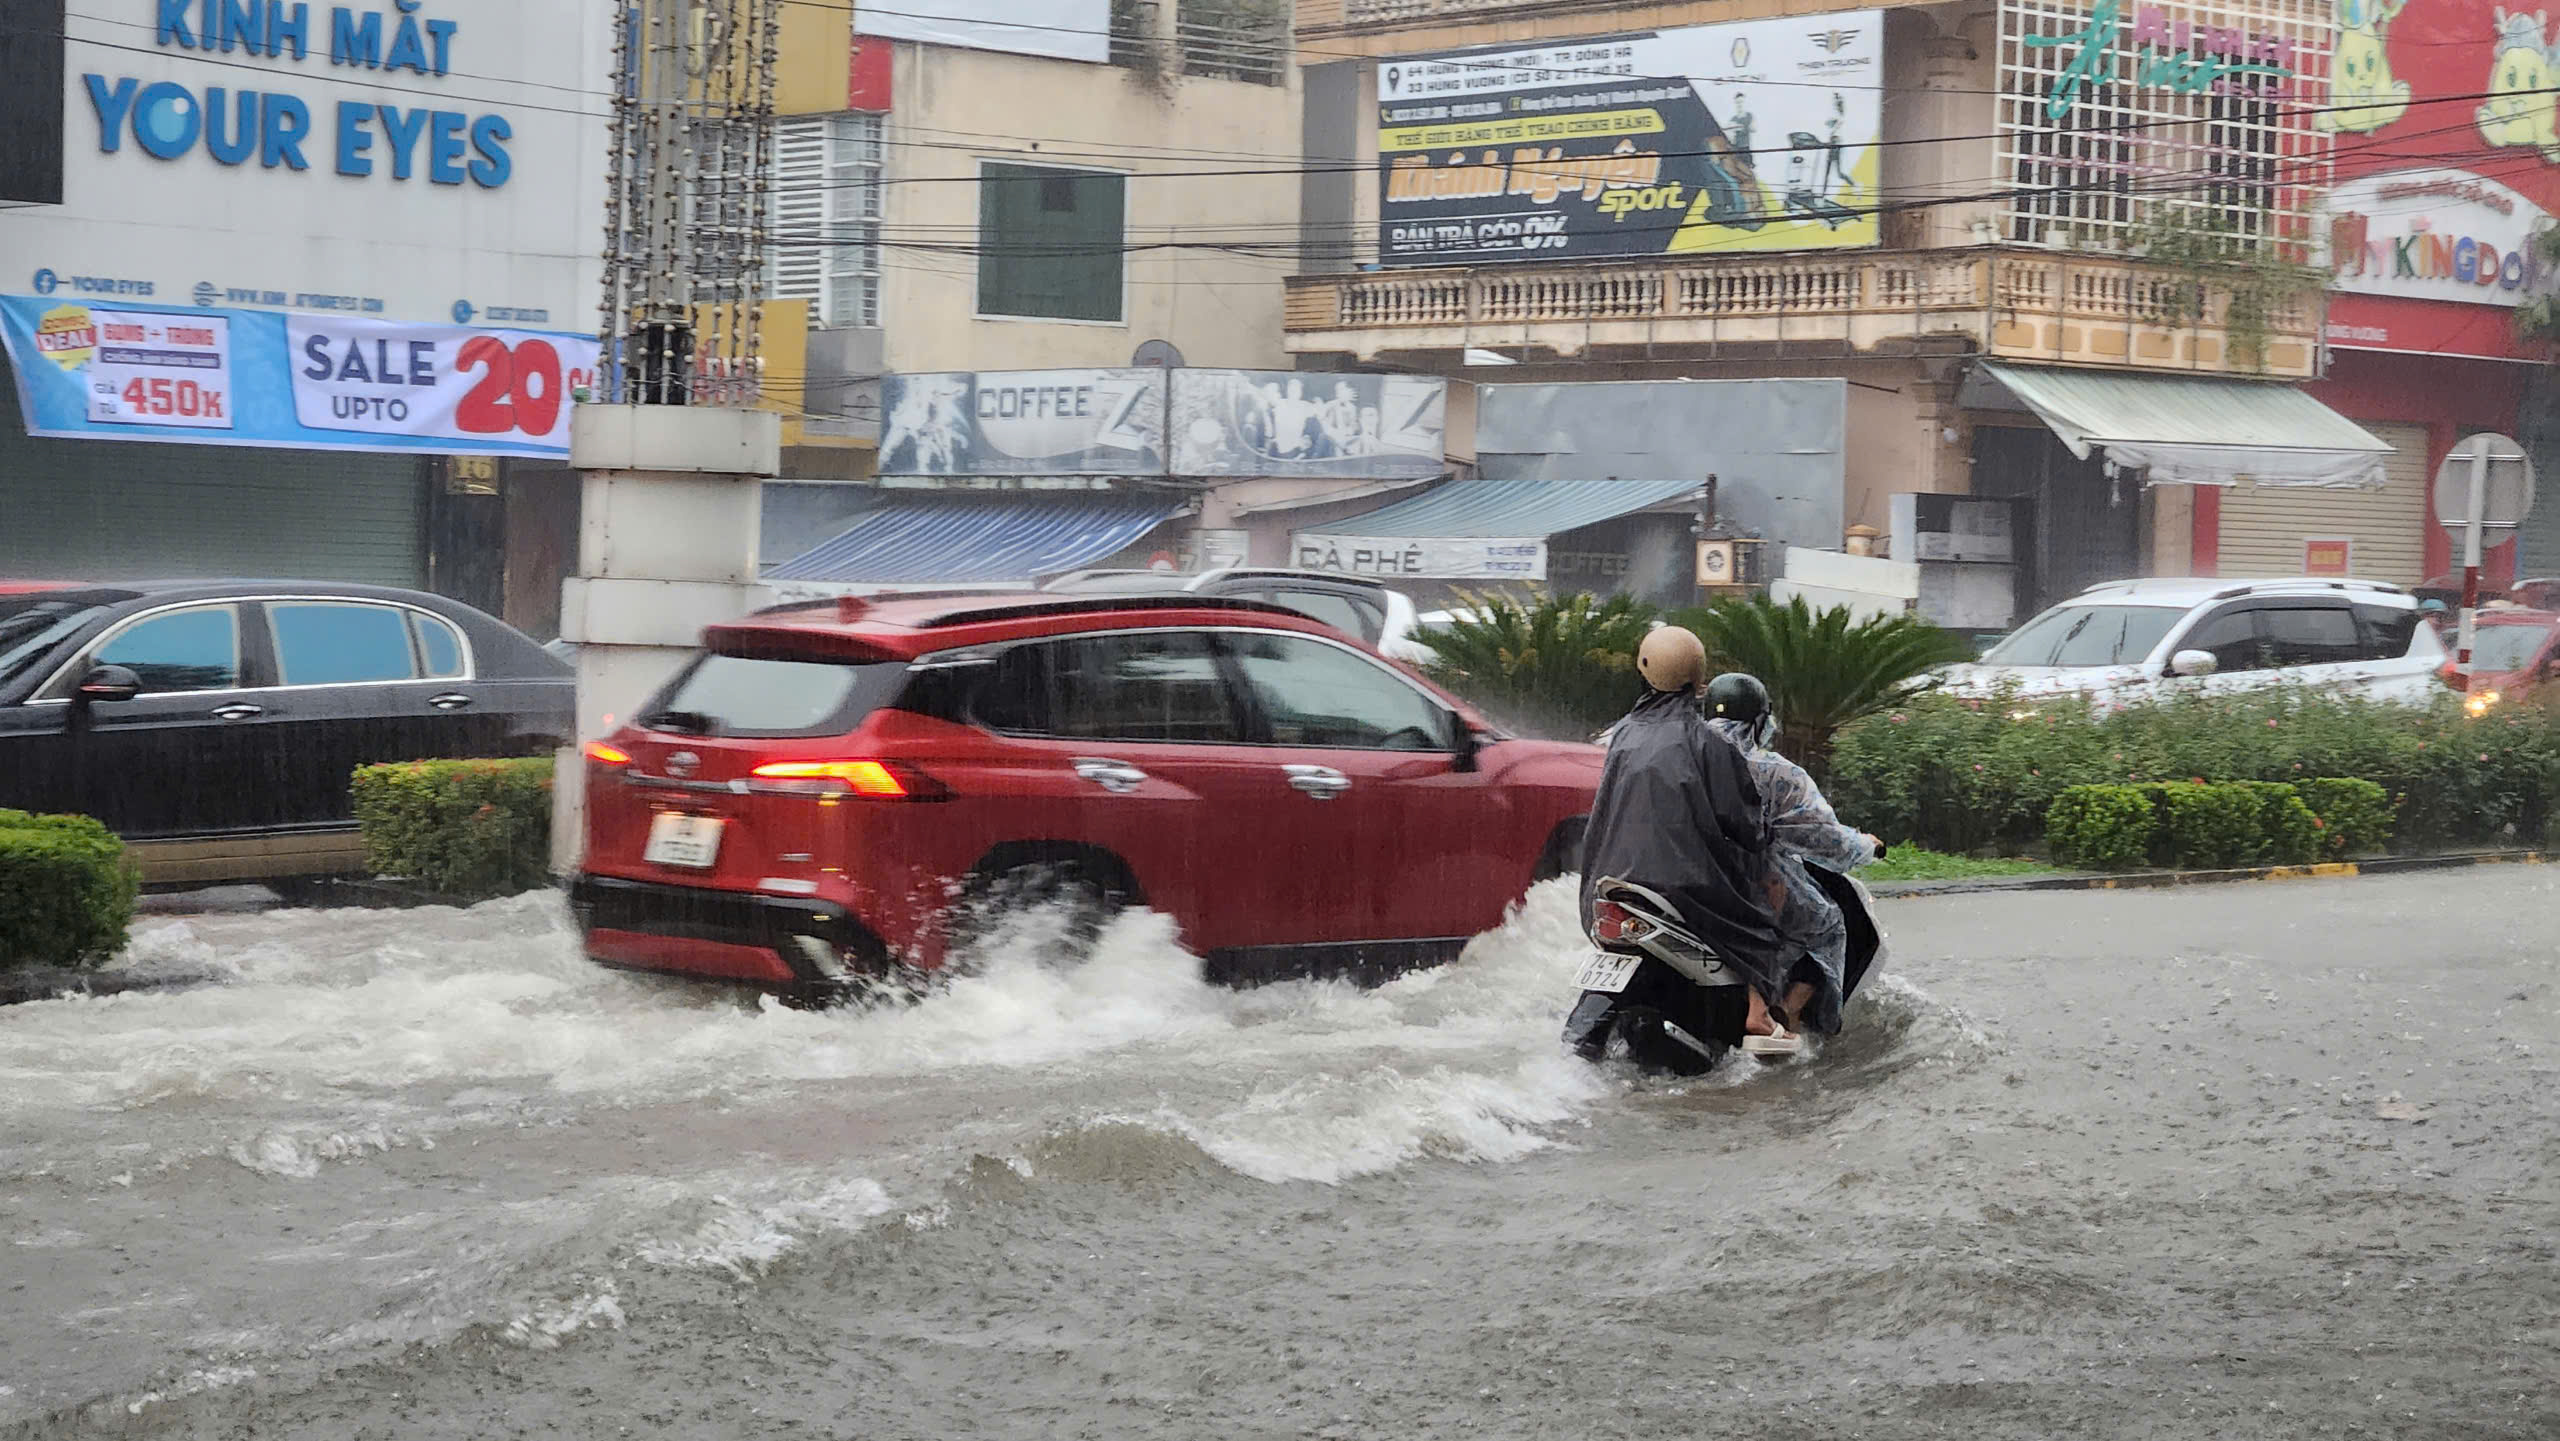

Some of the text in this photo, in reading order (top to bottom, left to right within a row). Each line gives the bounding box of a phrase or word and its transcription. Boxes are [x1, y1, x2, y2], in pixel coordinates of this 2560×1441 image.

[82, 73, 513, 189] YOUR EYES
[1597, 181, 1688, 222] sport
[1391, 223, 1435, 250] BÁN
[1520, 215, 1569, 250] 0%
[39, 327, 93, 351] DEAL
[303, 334, 437, 422] SALE UPTO
[122, 377, 224, 418] 450K
[977, 385, 1093, 418] COFFEE
[1300, 540, 1424, 573] CÀ PHÊ
